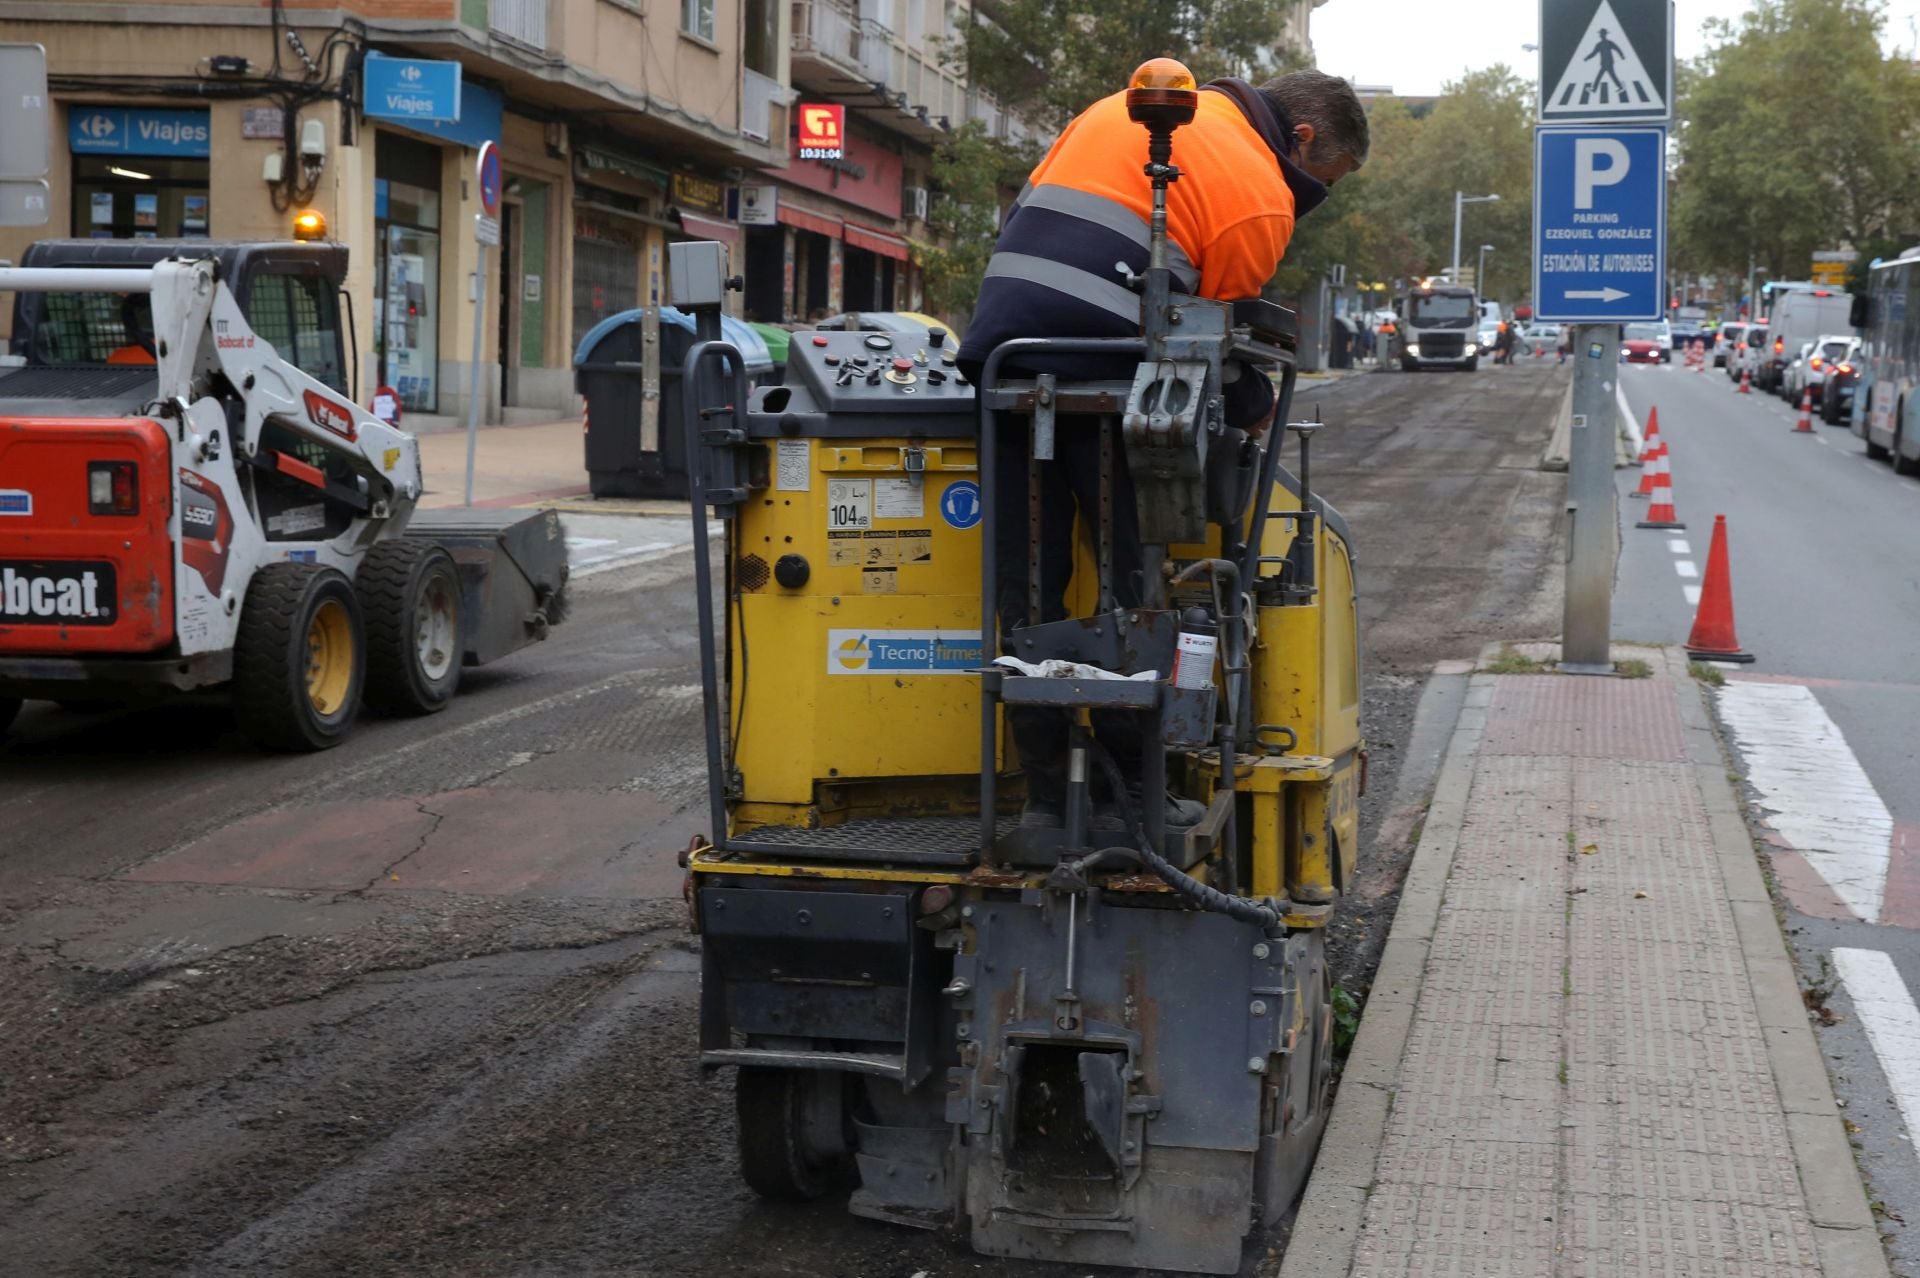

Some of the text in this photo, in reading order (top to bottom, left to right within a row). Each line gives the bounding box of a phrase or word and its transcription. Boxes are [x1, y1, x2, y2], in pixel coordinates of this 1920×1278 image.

[386, 94, 433, 114] Viajes
[139, 119, 208, 145] Viajes
[1574, 138, 1631, 209] P
[1573, 213, 1619, 223] PARKING
[1545, 226, 1652, 239] EZEQUIEL GONZÁLEZ
[1543, 250, 1654, 272] ESTACIÓN DE AUTOBUSES
[217, 335, 244, 349] Bobcat
[184, 504, 215, 526] S590
[831, 504, 868, 526] 104 dB
[877, 644, 928, 660] Tecno
